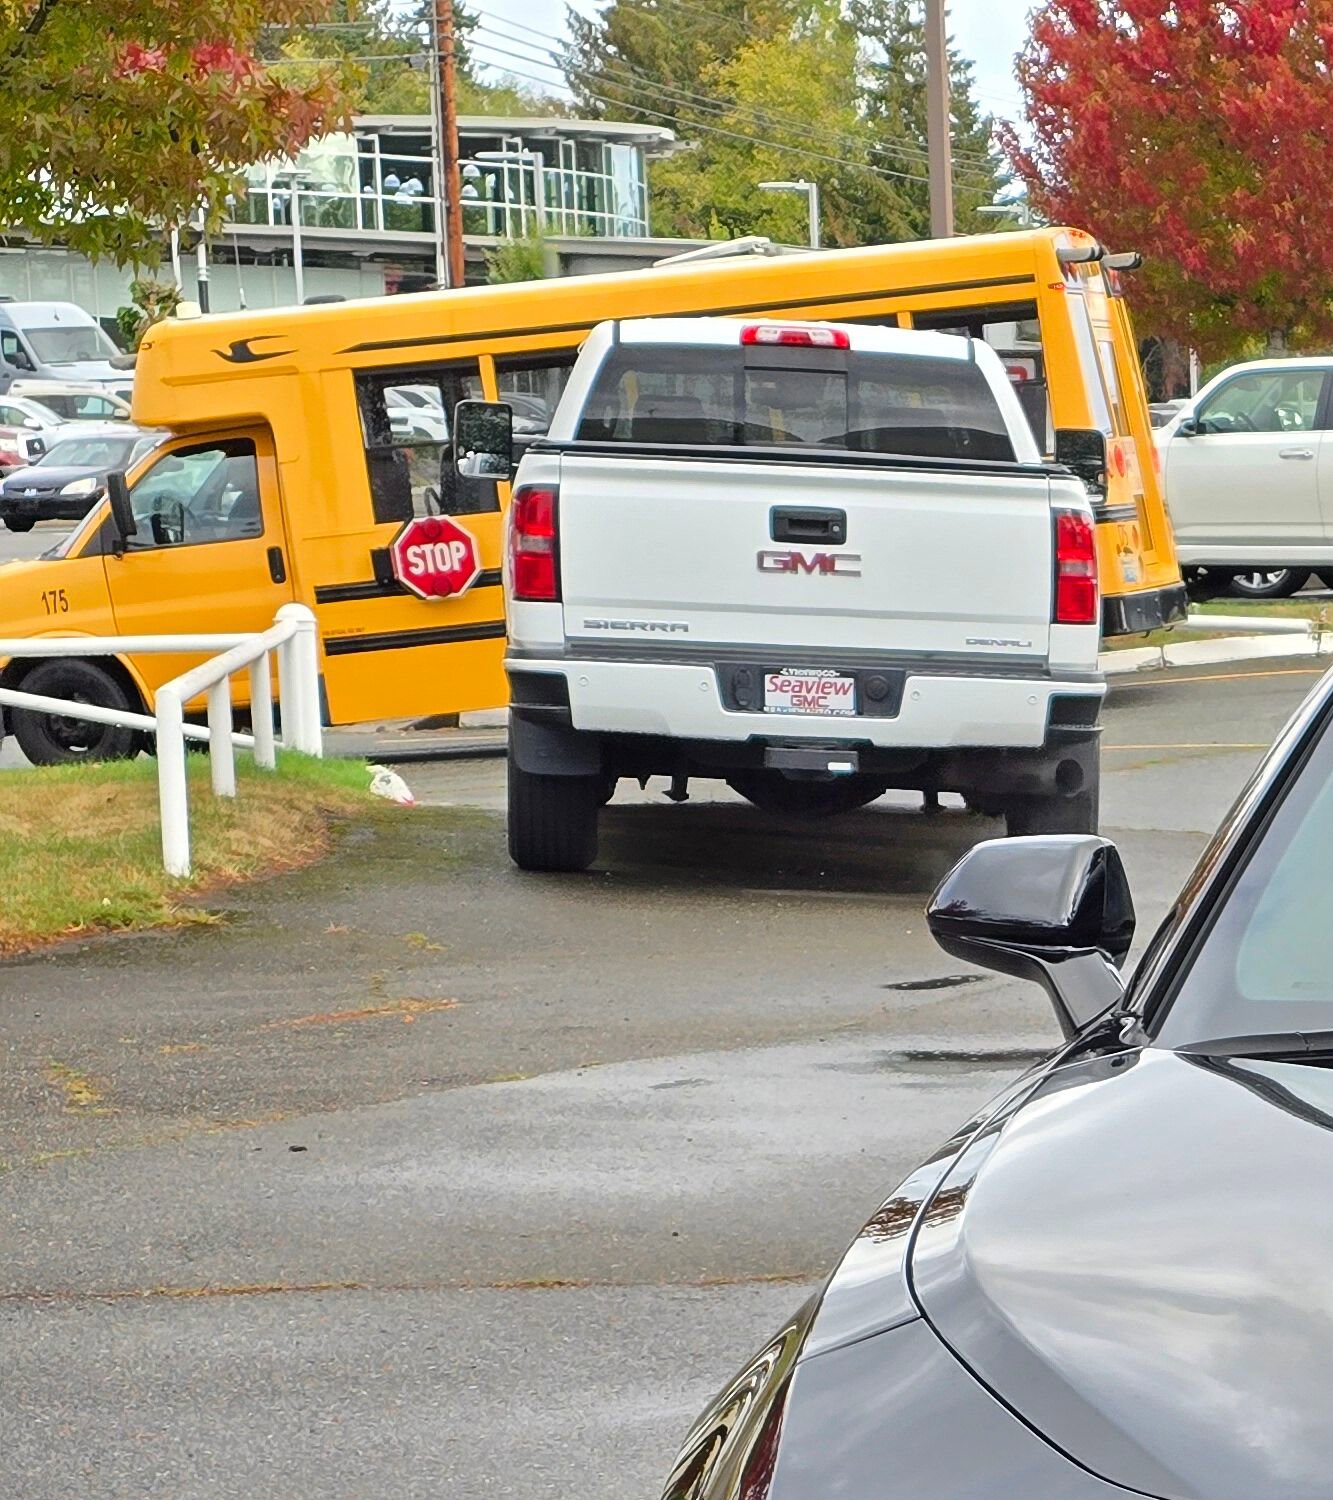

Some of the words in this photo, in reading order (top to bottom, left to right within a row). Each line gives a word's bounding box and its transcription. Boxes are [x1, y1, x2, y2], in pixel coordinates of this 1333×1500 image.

[406, 540, 466, 576] STOP
[757, 550, 862, 577] GMC
[41, 589, 69, 615] 175
[583, 619, 689, 632] SIERRA
[965, 638, 1033, 648] DENALI
[766, 675, 854, 696] Seaview
[791, 694, 830, 708] GMC
